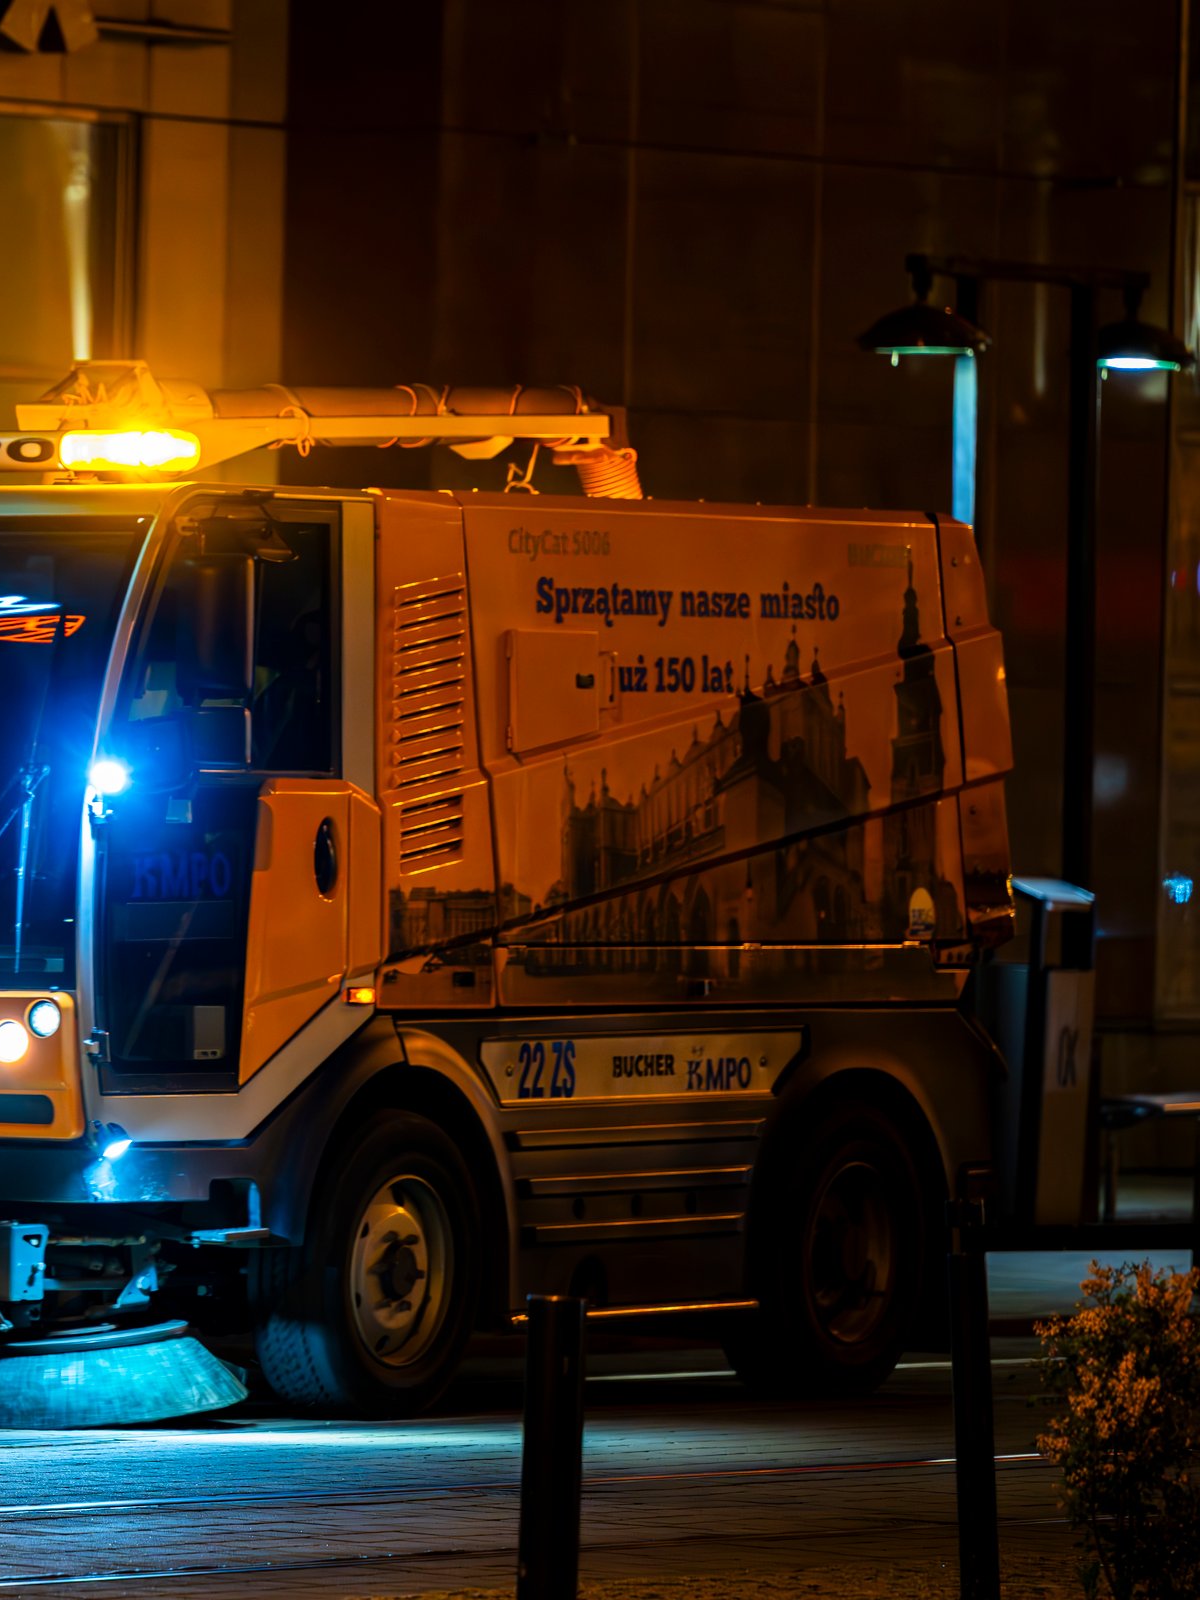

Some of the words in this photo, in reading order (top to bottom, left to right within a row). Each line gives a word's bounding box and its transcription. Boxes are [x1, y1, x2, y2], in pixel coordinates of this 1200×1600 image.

[536, 577, 674, 627] Sprzątamy
[680, 589, 751, 619] nasze
[760, 581, 840, 621] miasto
[655, 656, 696, 693] 150
[701, 655, 735, 693] lat
[612, 1053, 676, 1078] BUCHER
[686, 1055, 752, 1092] KMPO
